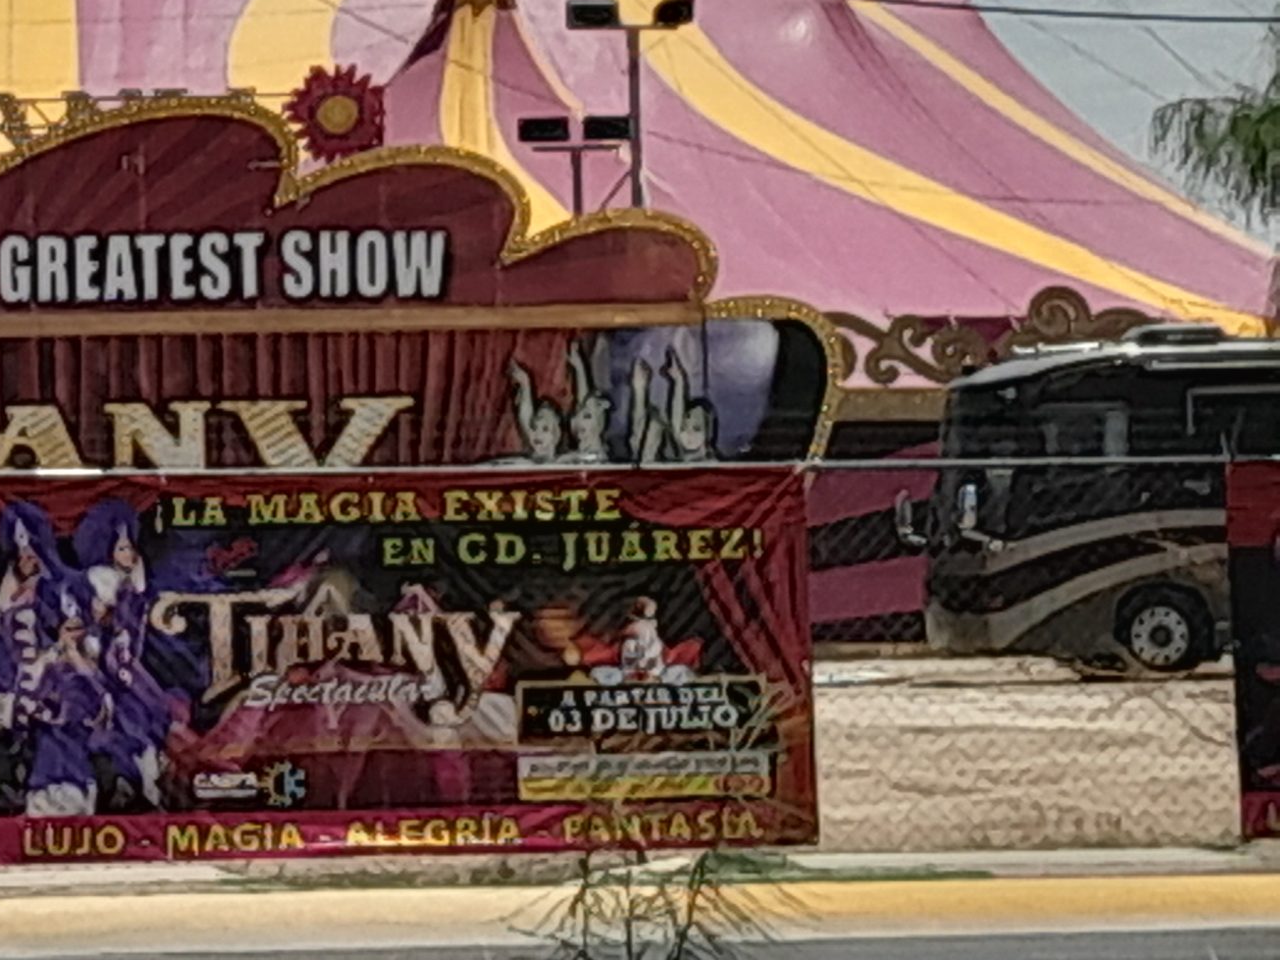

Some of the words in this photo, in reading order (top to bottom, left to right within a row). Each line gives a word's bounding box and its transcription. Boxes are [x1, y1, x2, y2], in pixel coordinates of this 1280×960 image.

[281, 229, 447, 299] SHOW
[246, 491, 418, 525] MAGIA
[443, 488, 622, 522] EXISTE
[383, 537, 435, 566] EN
[457, 532, 542, 565] CD.
[561, 522, 763, 571] JUÁREZ!
[548, 709, 582, 732] 03
[592, 707, 639, 731] DE
[645, 704, 738, 734] JULIO
[23, 823, 124, 856] LUJO
[166, 822, 304, 858] MAGIA
[346, 814, 520, 847] ALEGRÍA
